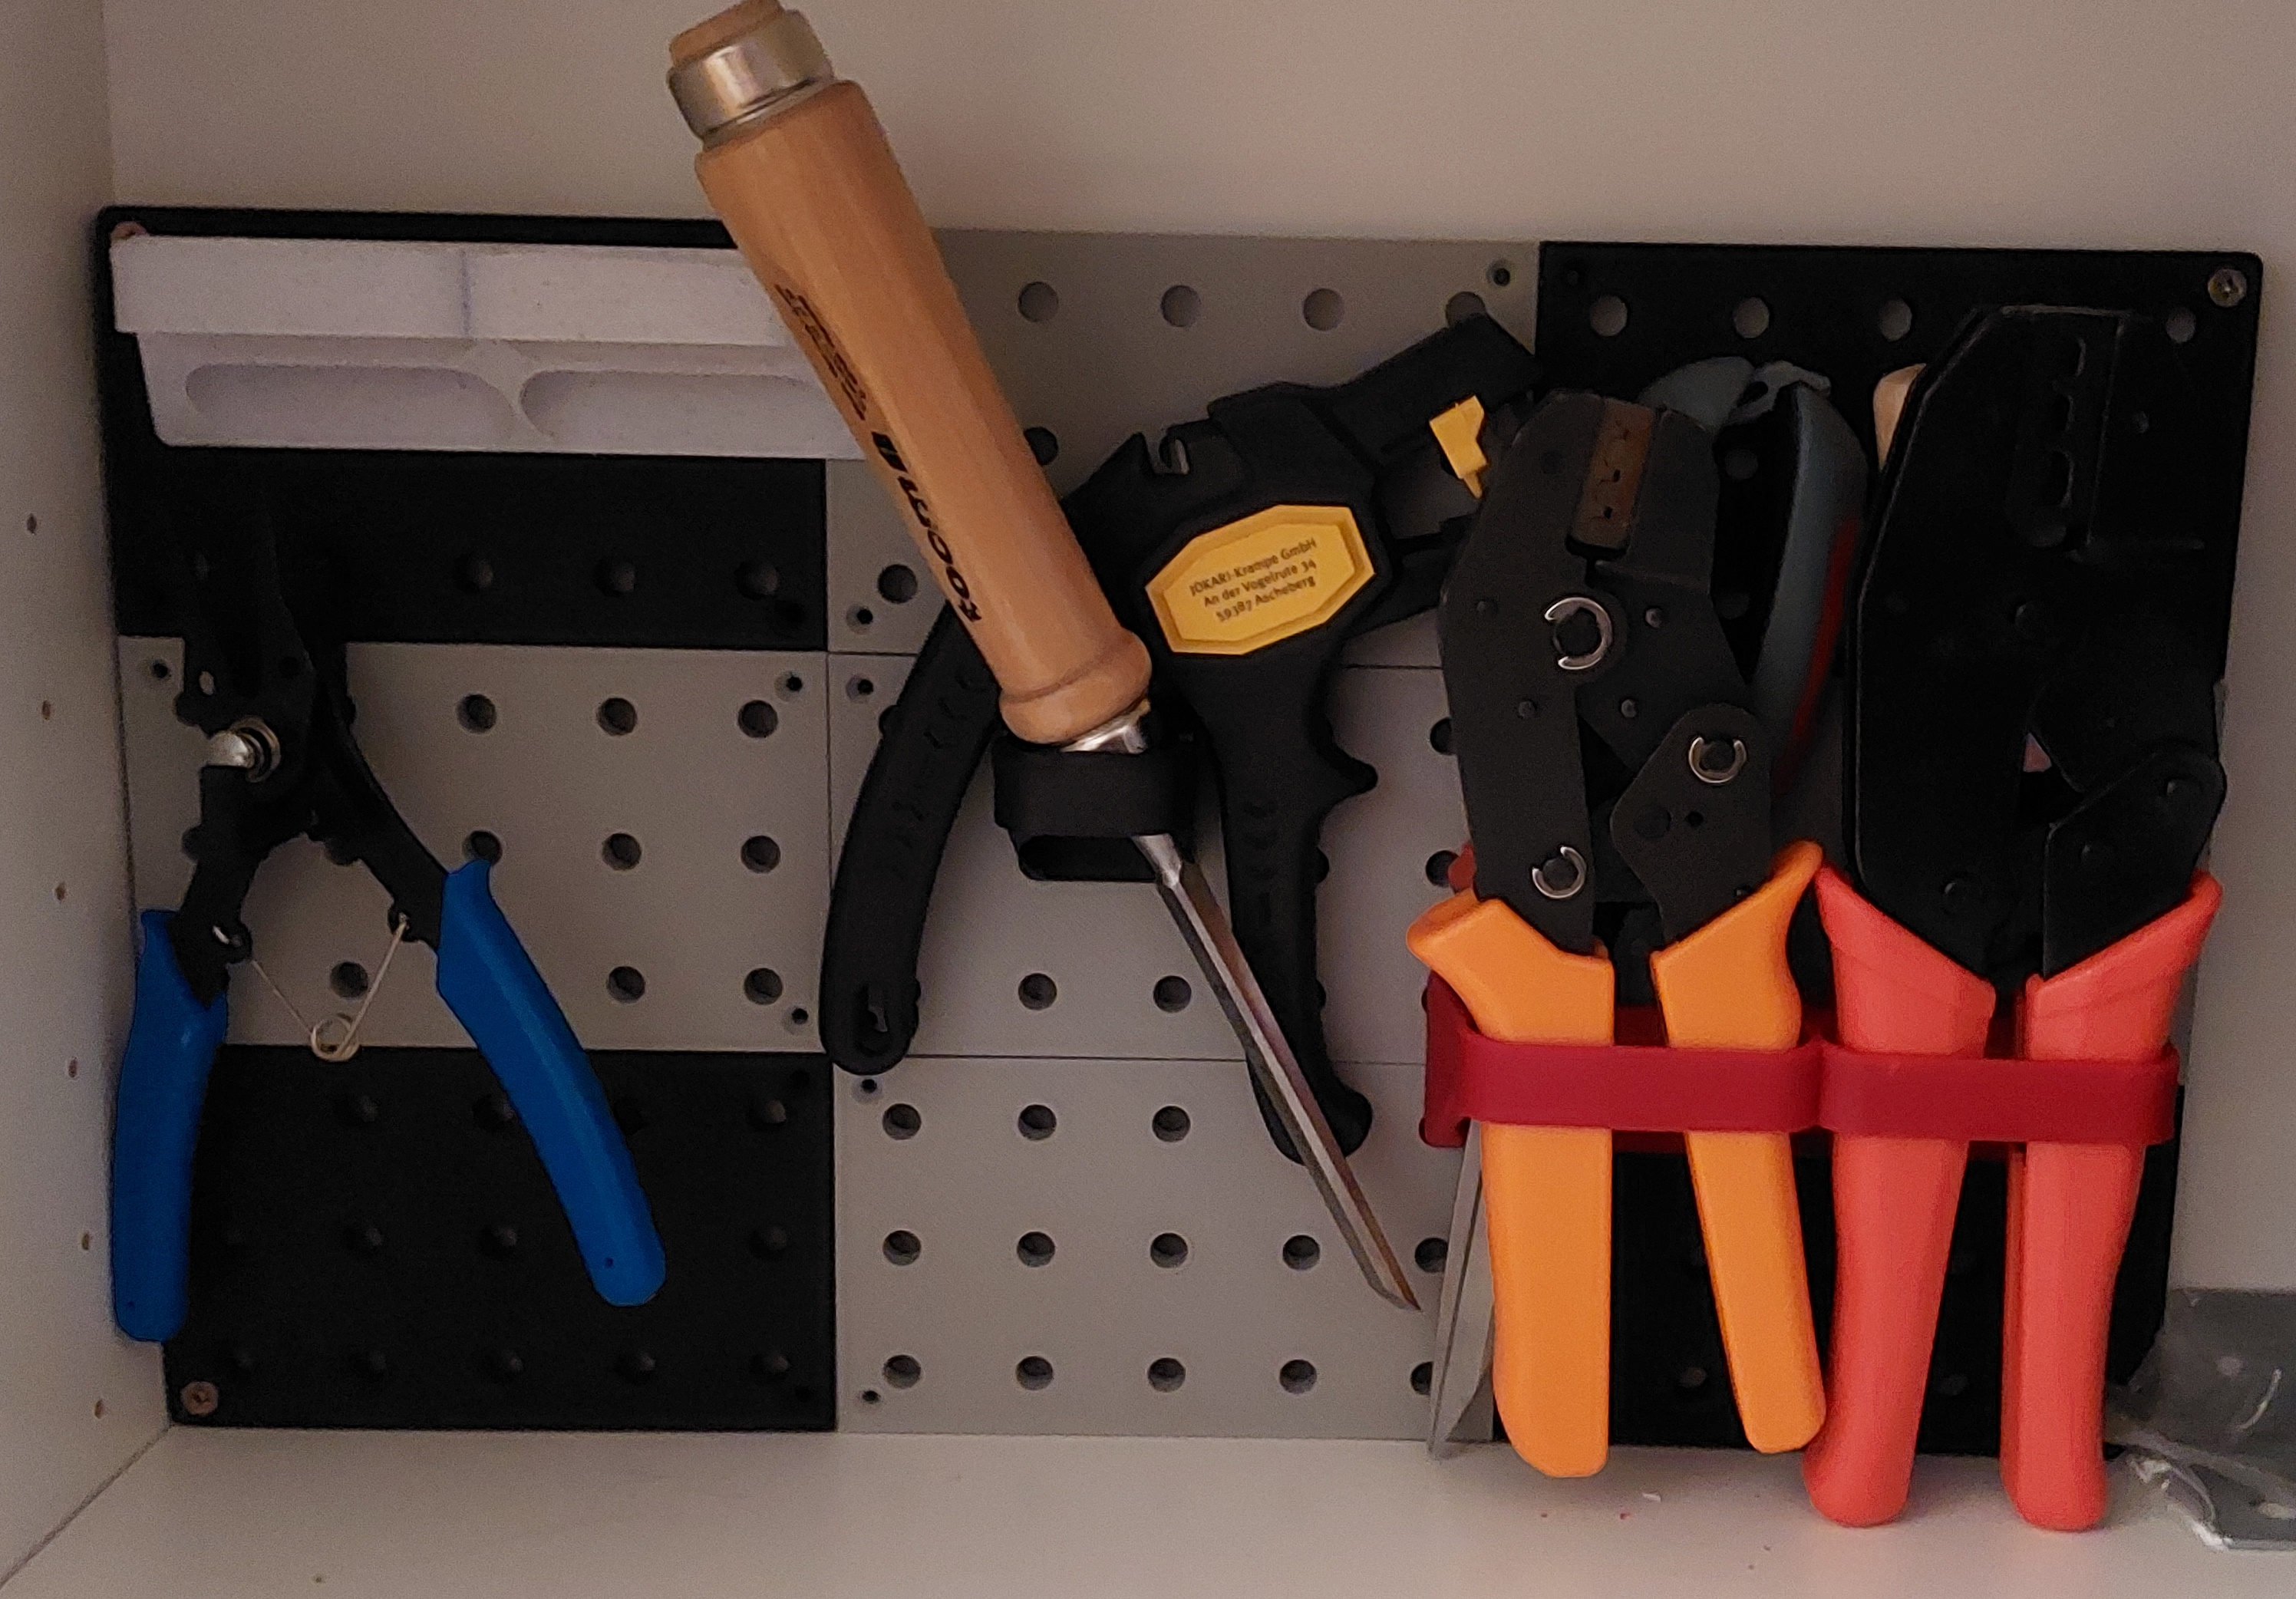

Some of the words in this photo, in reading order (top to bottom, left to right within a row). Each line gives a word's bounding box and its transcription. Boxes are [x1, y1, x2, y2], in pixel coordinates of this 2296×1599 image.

[1281, 538, 1317, 560] GmbH
[1204, 595, 1220, 608] An
[1222, 587, 1240, 600] der
[1301, 559, 1317, 572] 34
[1216, 601, 1252, 621] 59387
[1255, 577, 1316, 605] Ascheberg
